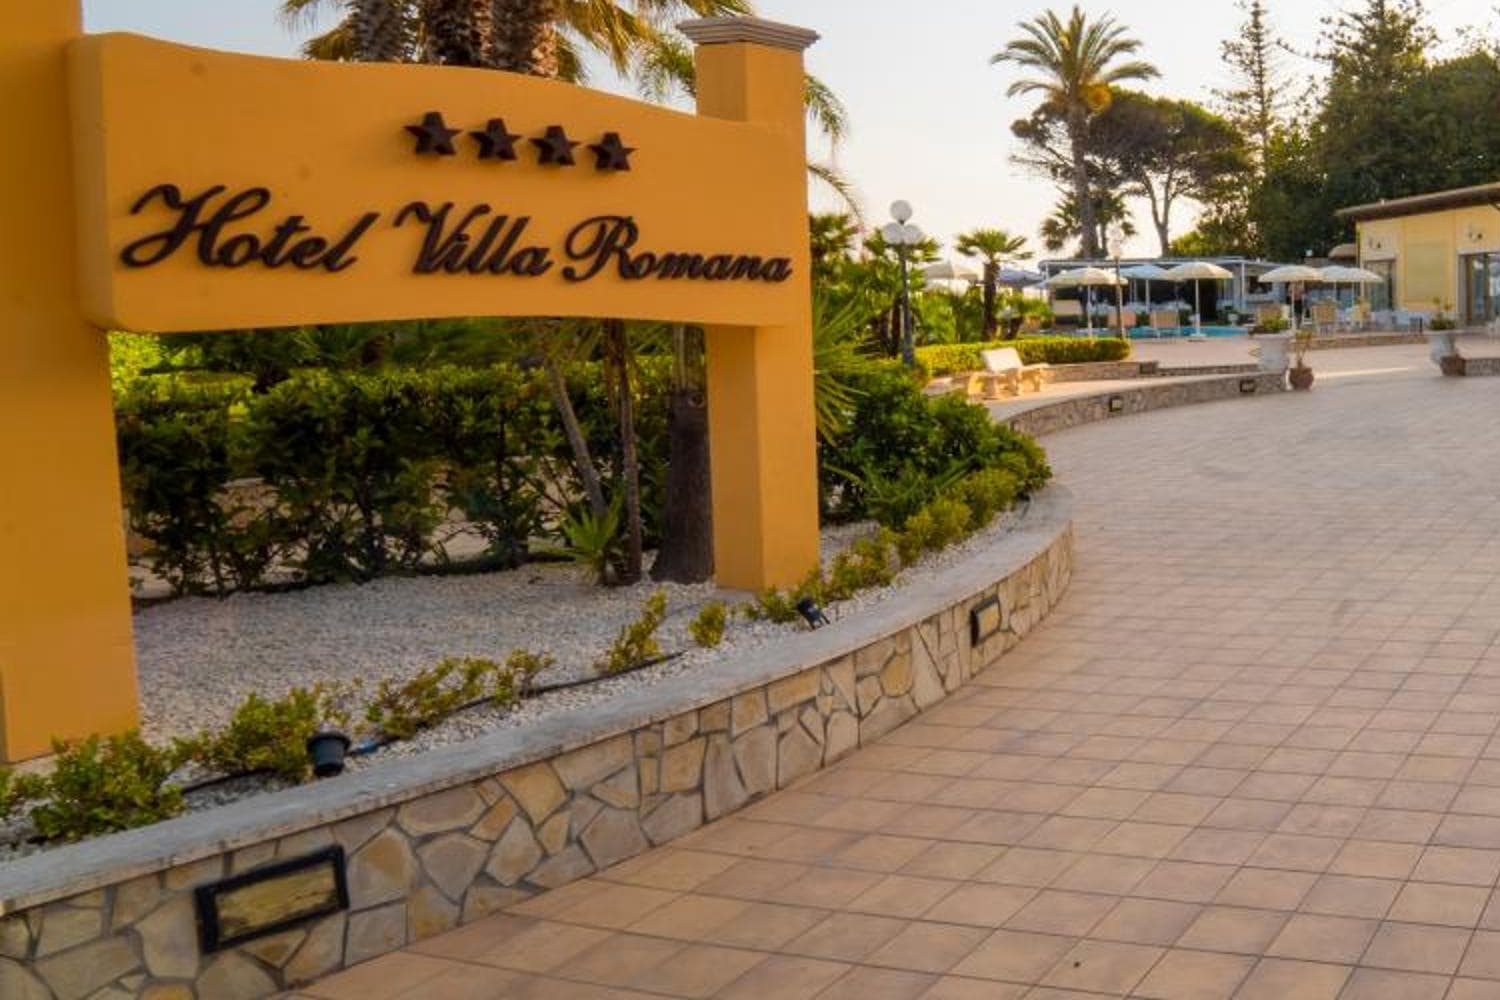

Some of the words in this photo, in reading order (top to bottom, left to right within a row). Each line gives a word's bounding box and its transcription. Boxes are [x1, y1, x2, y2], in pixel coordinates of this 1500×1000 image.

[118, 183, 380, 274] Hotel
[393, 201, 553, 277] Villa
[561, 215, 792, 283] Romana
